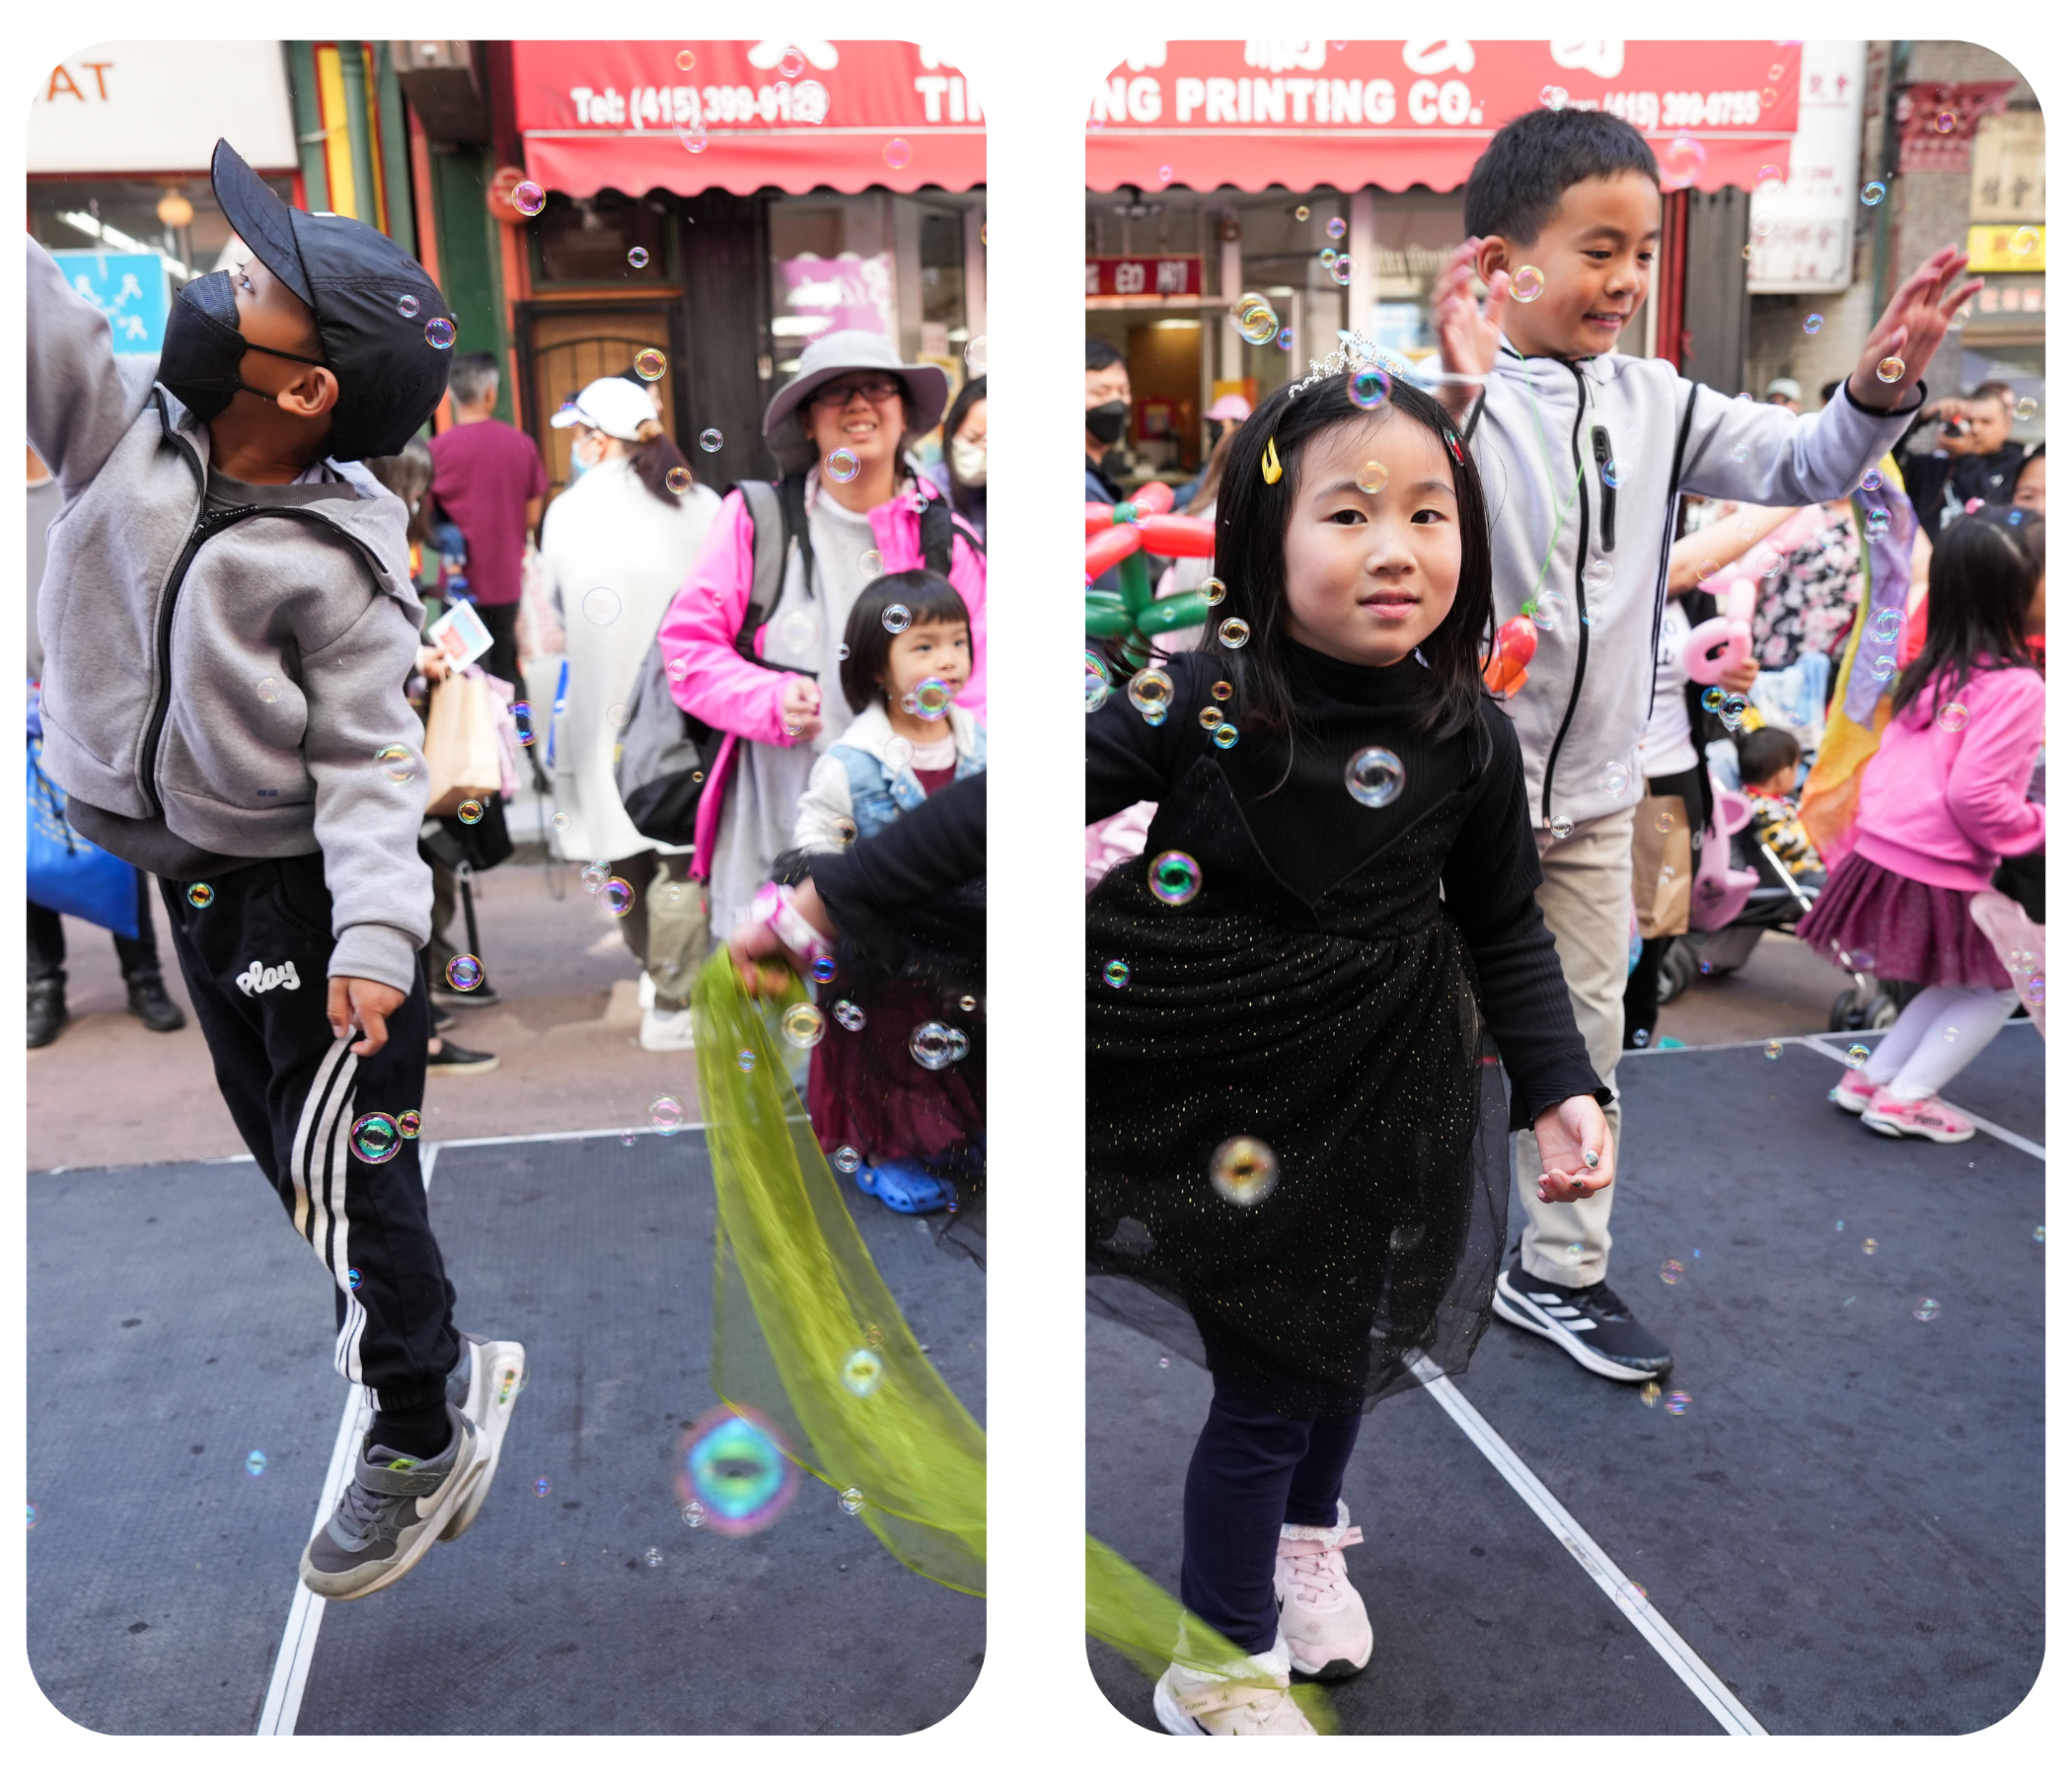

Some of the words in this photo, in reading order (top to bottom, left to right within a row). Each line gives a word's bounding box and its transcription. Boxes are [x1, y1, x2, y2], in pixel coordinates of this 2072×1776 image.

[37, 62, 113, 102] AT
[1087, 76, 1162, 123] NG
[1175, 77, 1397, 124] PRINTING
[1407, 79, 1483, 125] CO.
[570, 87, 626, 124] Tel:
